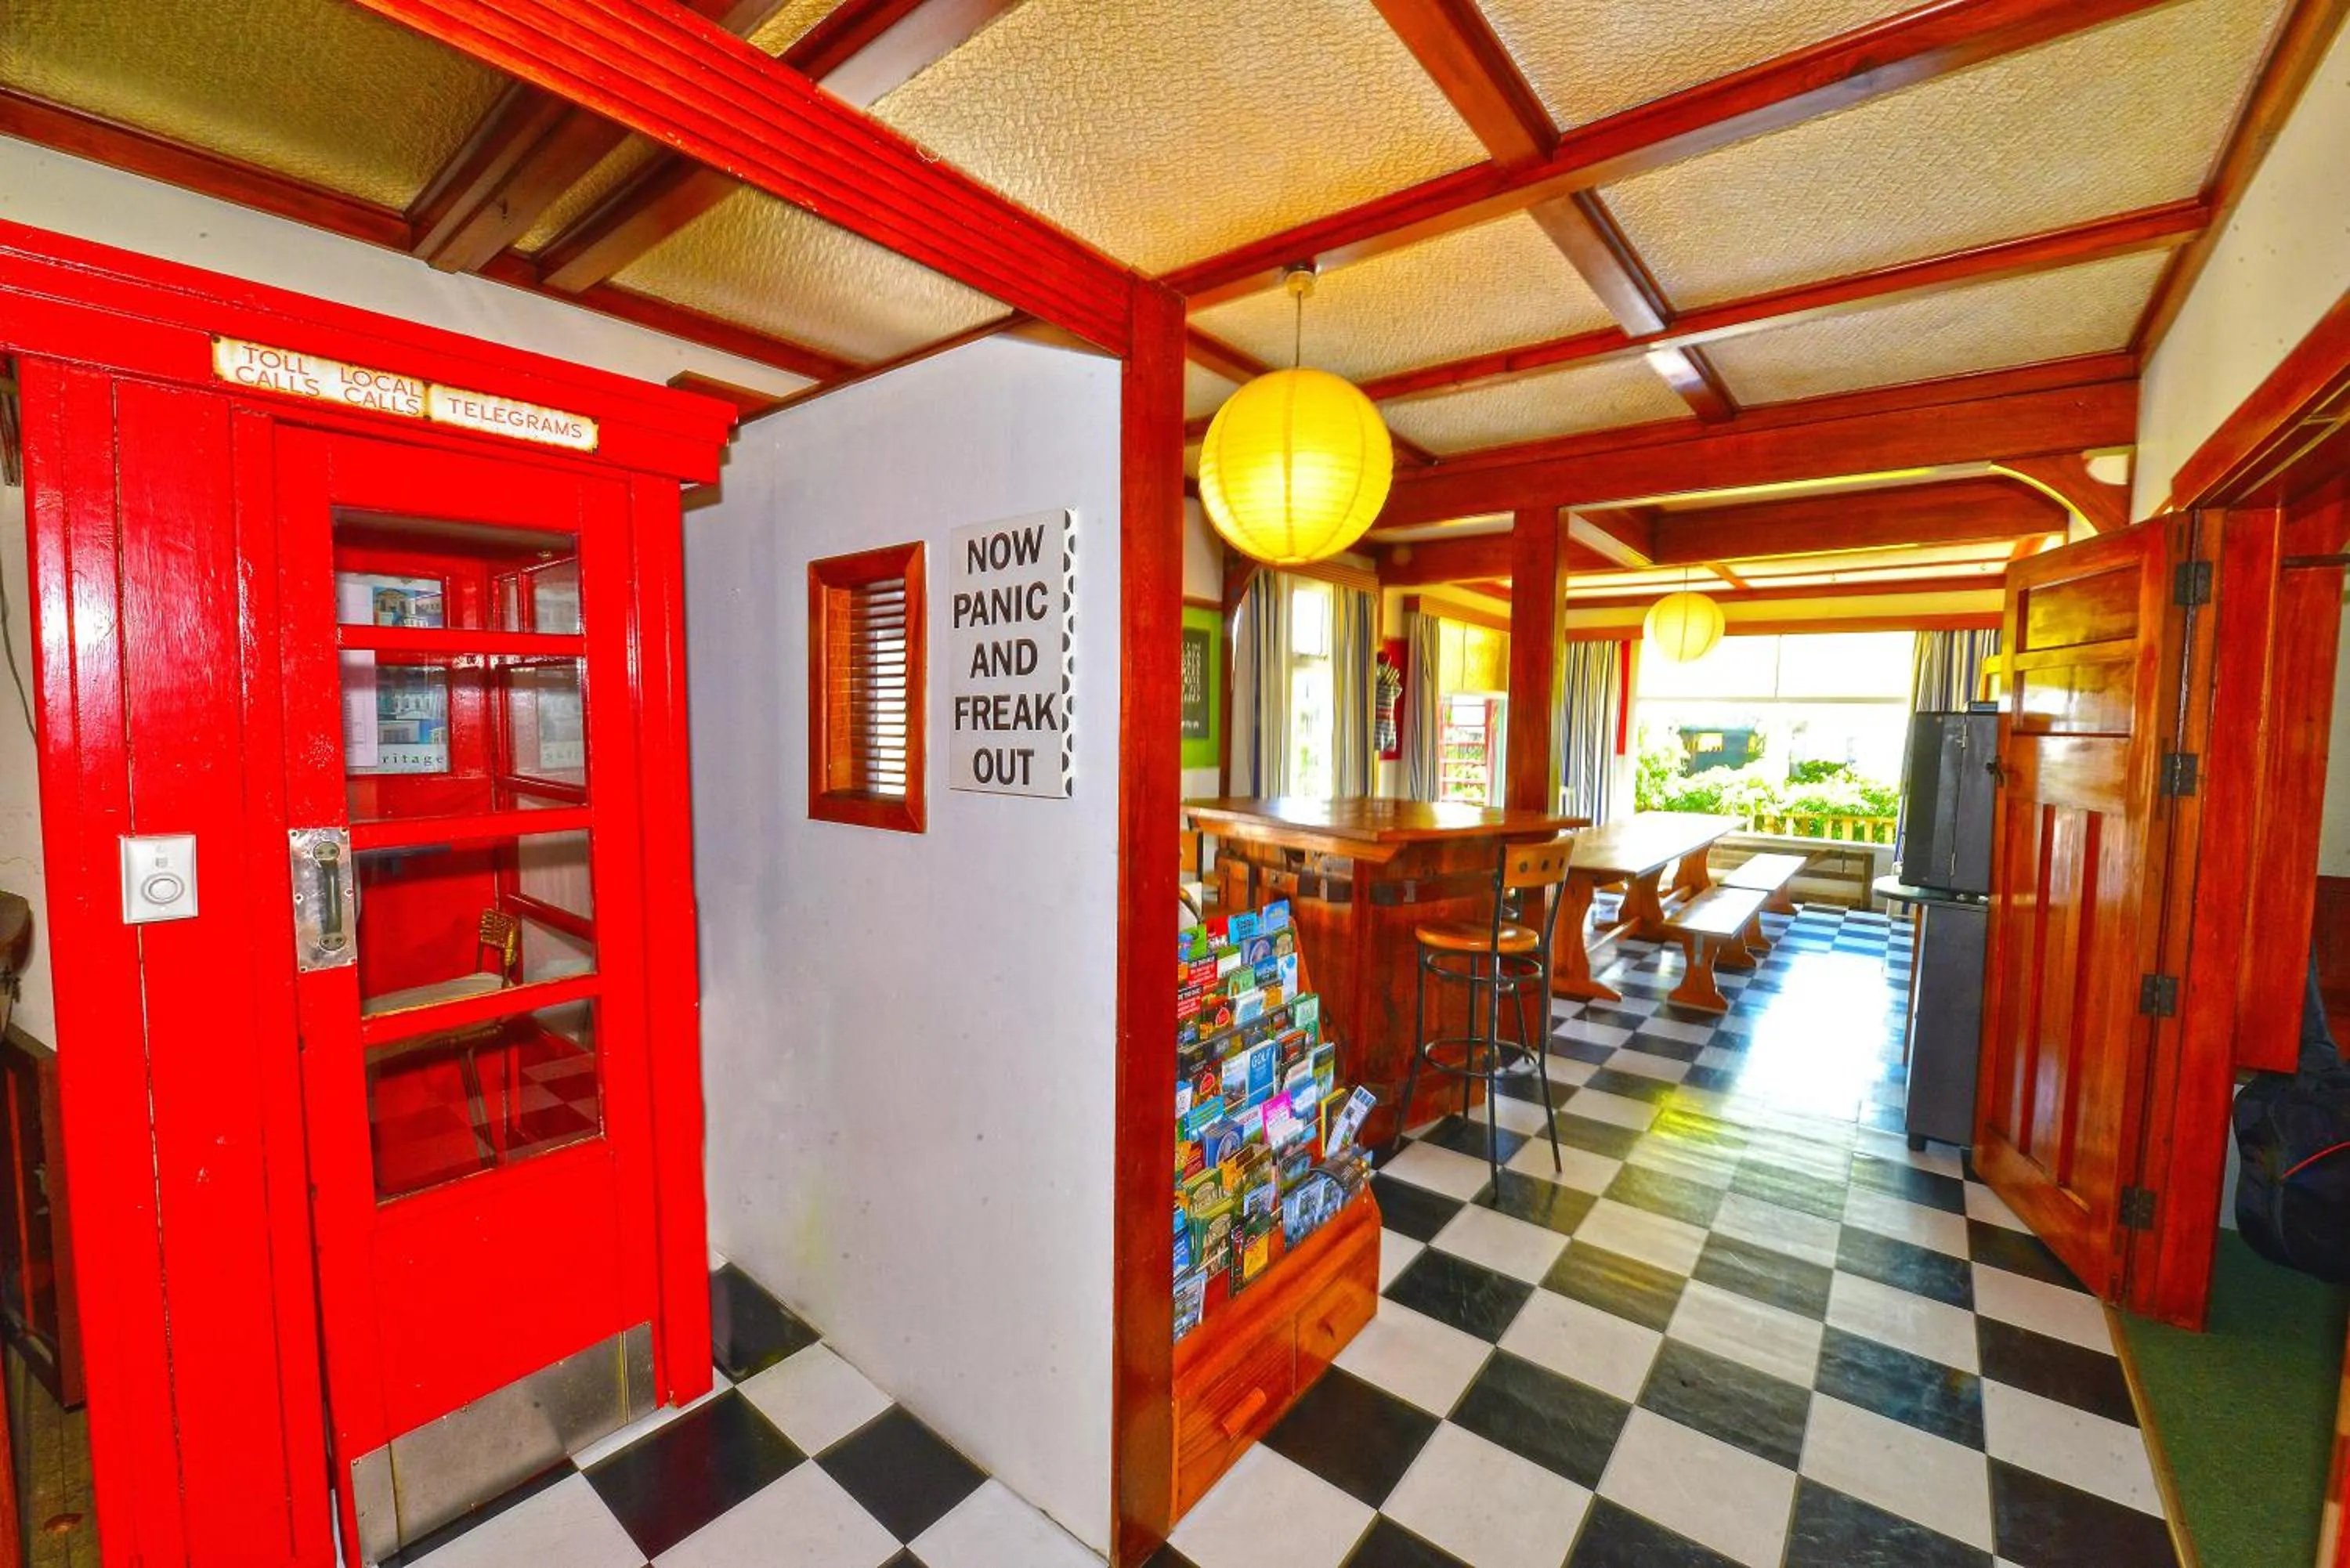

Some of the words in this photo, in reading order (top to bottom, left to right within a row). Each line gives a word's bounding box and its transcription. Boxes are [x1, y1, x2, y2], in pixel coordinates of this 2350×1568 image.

[242, 345, 309, 376] TOLL
[235, 366, 320, 397] CALLS
[341, 367, 422, 399] LOCAL
[343, 386, 421, 416] CALLS
[447, 397, 583, 439] TELEGRAMS
[967, 524, 1044, 575] NOW
[953, 580, 1049, 629] PANIC
[969, 638, 1039, 679] AND
[954, 692, 1058, 731] FREAK
[381, 752, 444, 767] ritage
[973, 747, 1035, 786] OUT
